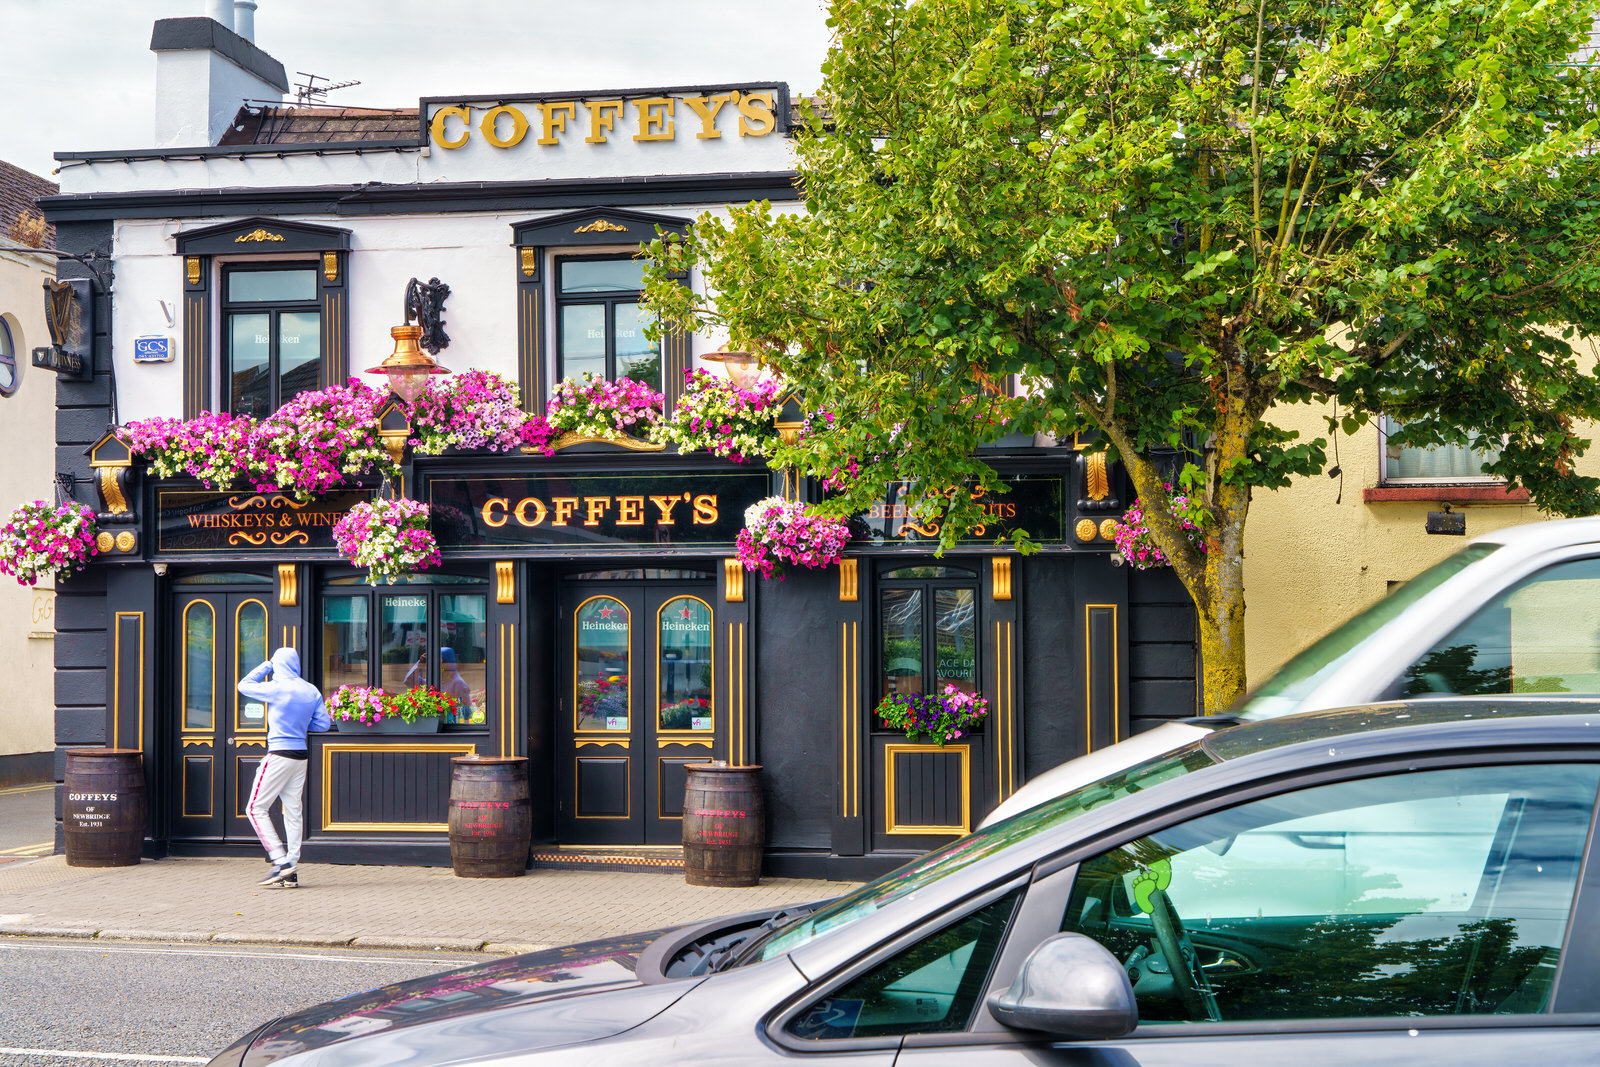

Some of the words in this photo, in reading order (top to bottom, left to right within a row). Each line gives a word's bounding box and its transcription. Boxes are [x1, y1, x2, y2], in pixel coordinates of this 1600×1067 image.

[430, 90, 775, 149] COFFEY'S
[587, 328, 636, 339] Heiken
[255, 334, 300, 344] Heiken
[136, 340, 167, 352] GCS
[481, 491, 719, 528] COFFEY'S
[187, 513, 275, 528] WHISKEYS
[279, 513, 292, 527] &
[385, 598, 427, 607] Heineke
[662, 621, 710, 631] Heineken
[939, 659, 959, 667] ACE
[963, 659, 975, 667] DA
[69, 793, 117, 801] COFFEYS
[459, 801, 510, 810] COFFEYS
[695, 809, 746, 819] COFFEYS
